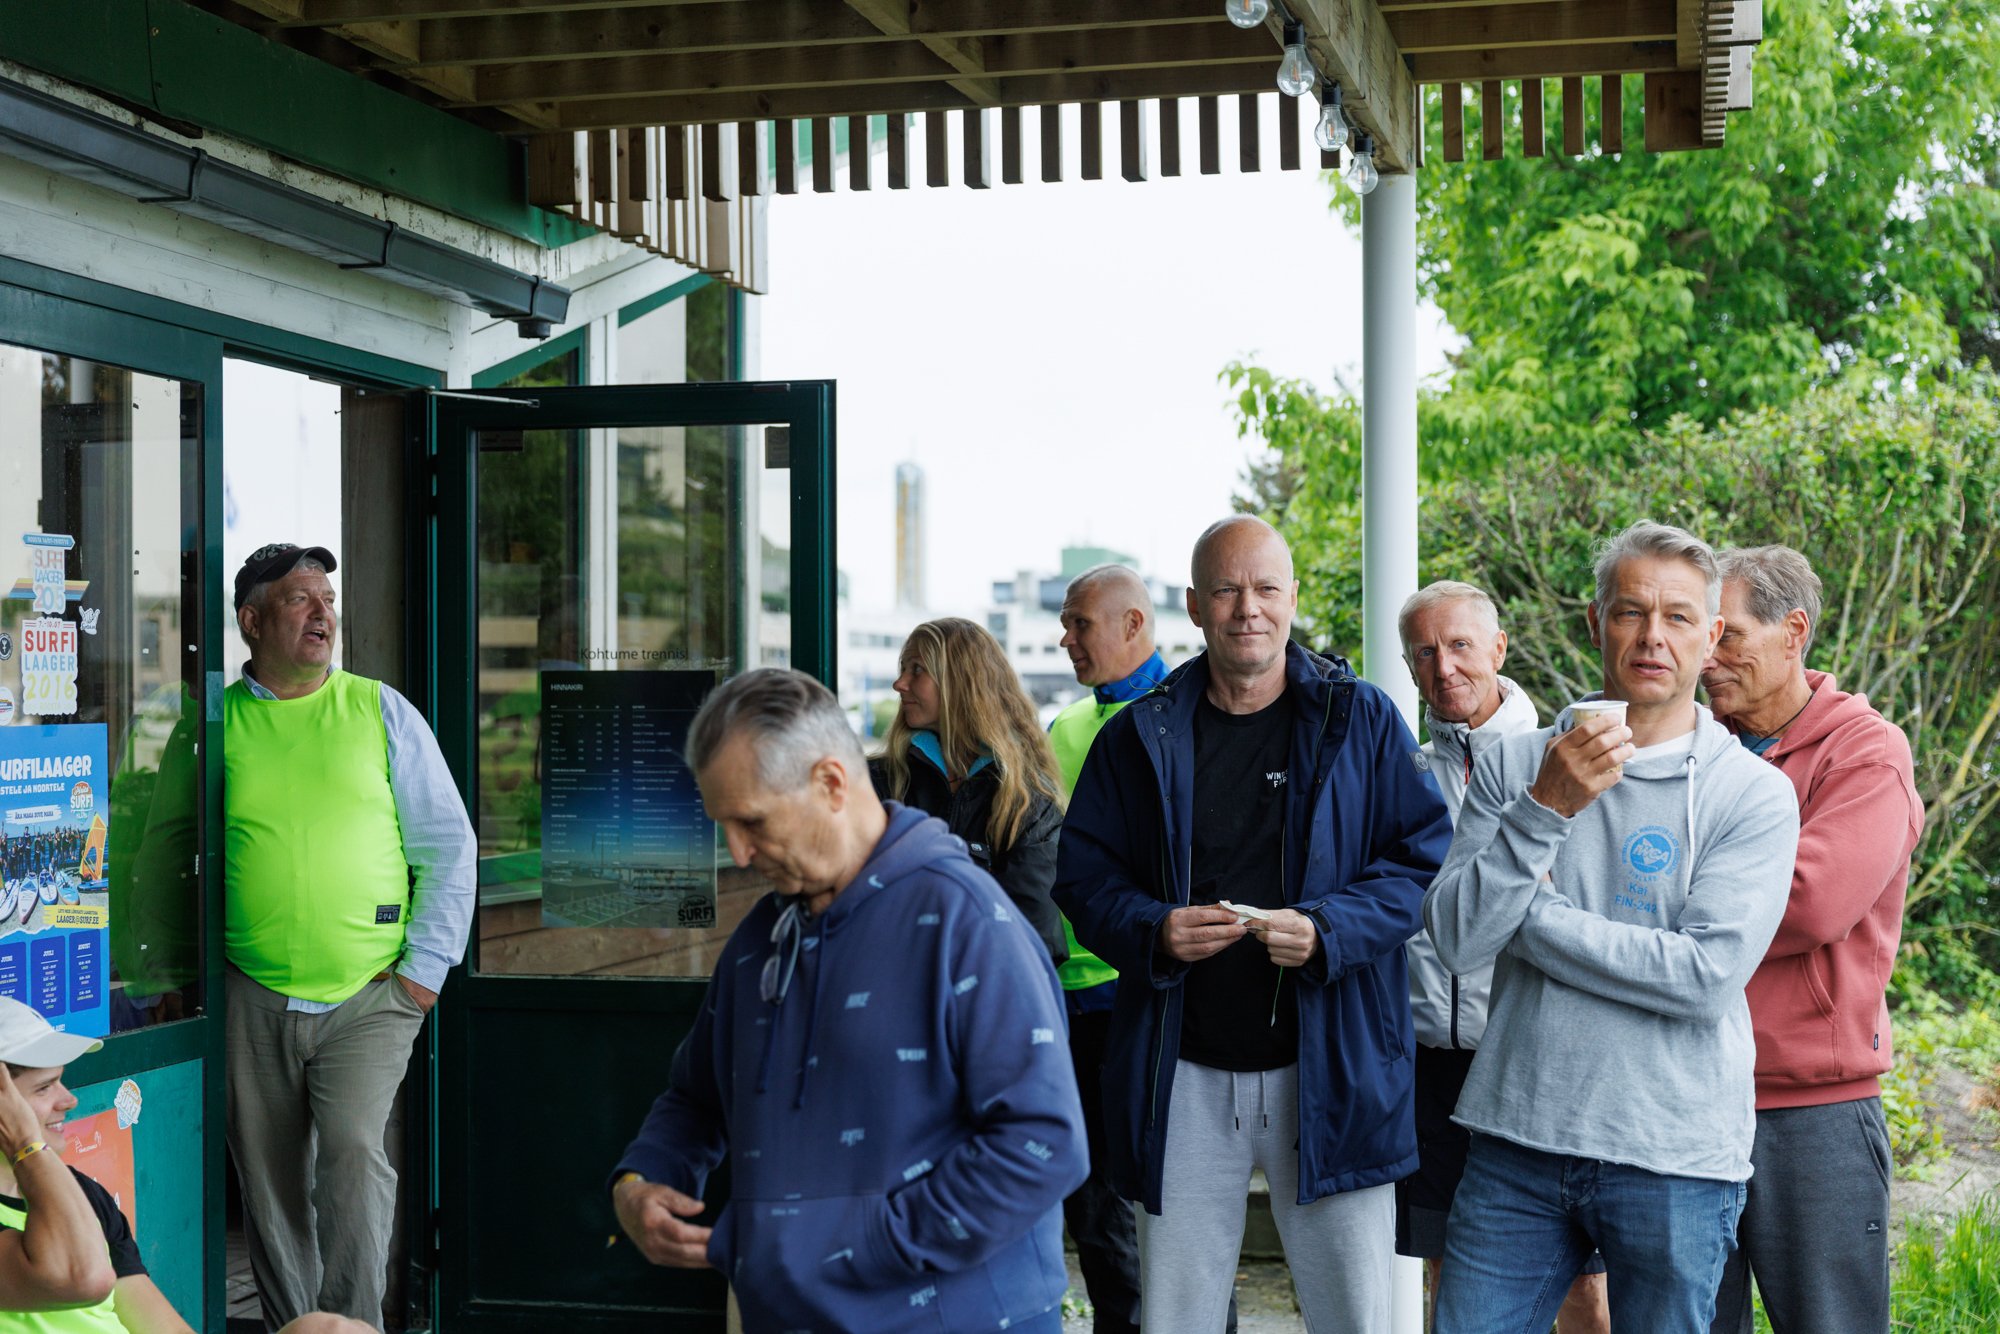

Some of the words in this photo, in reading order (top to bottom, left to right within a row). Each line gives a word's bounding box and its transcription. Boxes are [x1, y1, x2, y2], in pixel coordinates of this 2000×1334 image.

[24, 629, 75, 653] SURFI
[24, 654, 75, 672] LAAGER
[581, 648, 638, 661] Kohtume
[25, 672, 75, 701] 2016
[0, 755, 92, 781] URFILAAGER
[22, 784, 32, 794] JA
[1614, 895, 1658, 914] FIN-242
